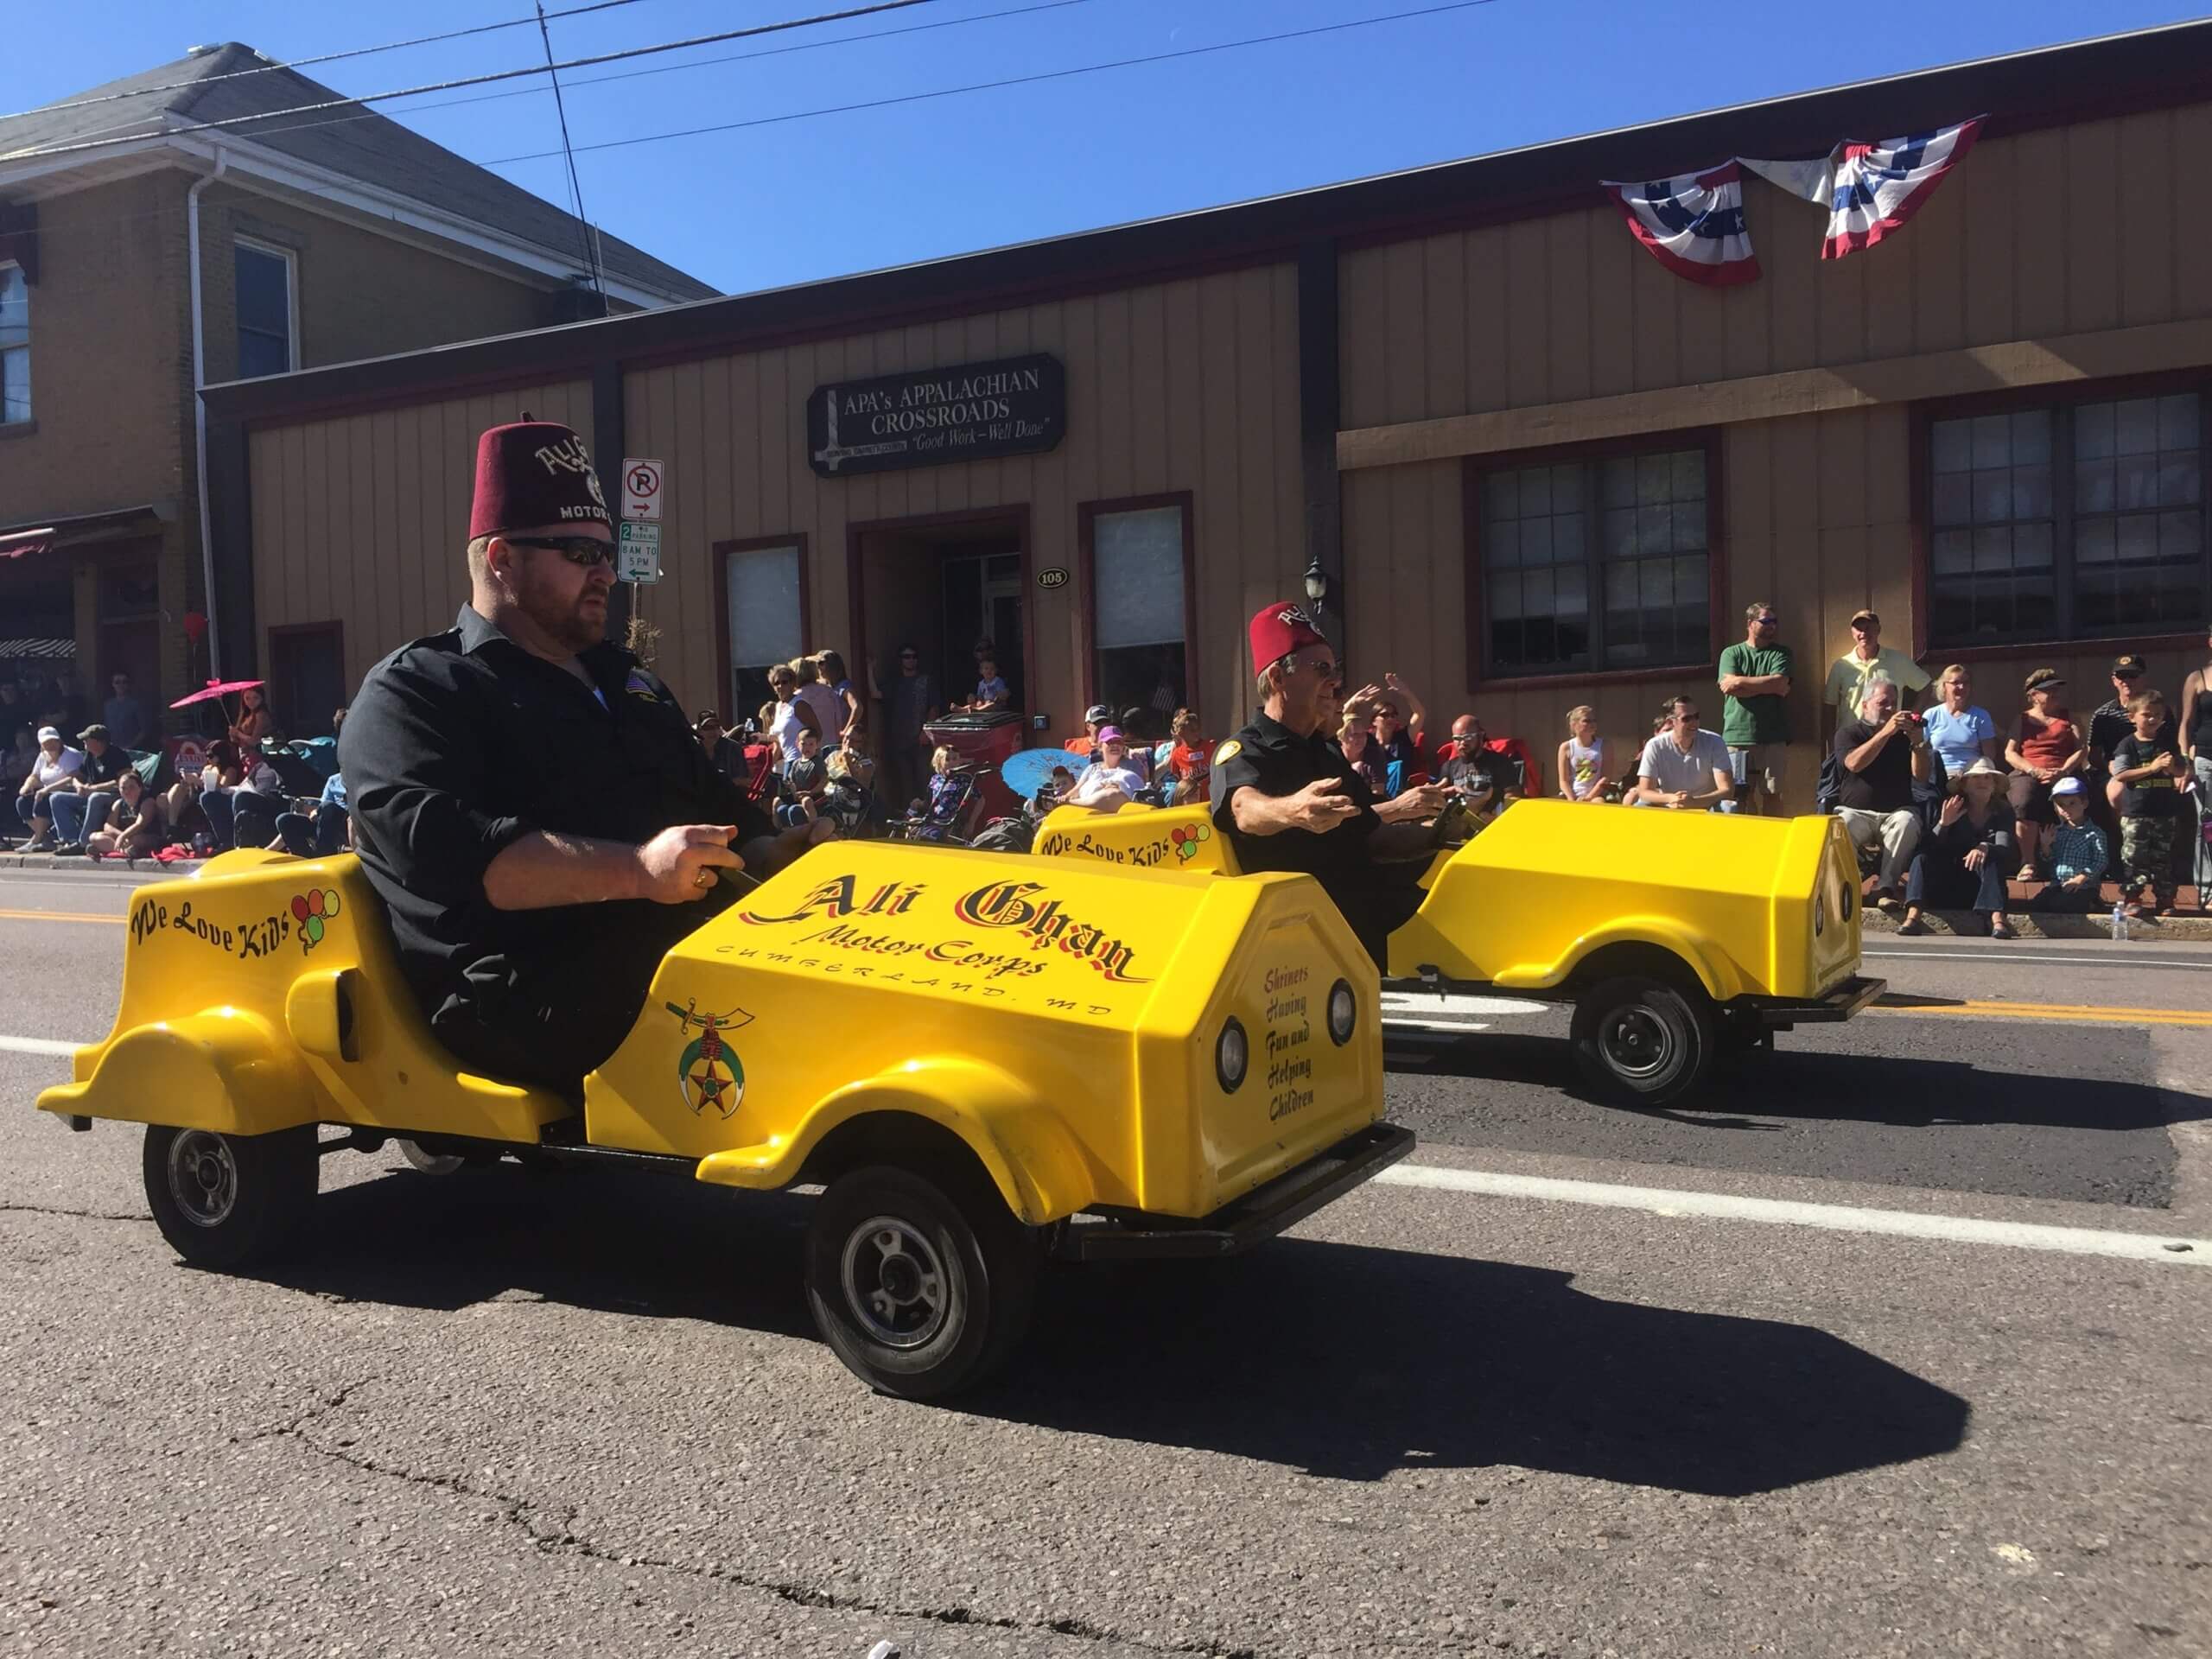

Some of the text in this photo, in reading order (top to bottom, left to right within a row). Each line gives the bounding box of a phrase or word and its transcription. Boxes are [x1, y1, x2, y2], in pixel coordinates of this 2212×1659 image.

[844, 369, 1039, 415] APA's APPALACHIAN
[871, 398, 1011, 435] CROSSROADS
[622, 526, 630, 538] 2
[646, 546, 657, 555] TO
[1042, 572, 1062, 584] 105
[1042, 833, 1071, 855] We
[1077, 834, 1123, 864] Love
[131, 899, 167, 945] We
[174, 901, 232, 951] Love
[738, 874, 1155, 983] Ali Ghan
[791, 924, 1048, 980] Motor Corps
[1264, 966, 1309, 994] Shriners
[1046, 997, 1112, 1016] MD
[1268, 993, 1306, 1023] Having
[1265, 1020, 1310, 1060] Fun and
[1268, 1056, 1313, 1090] Helping
[1268, 1089, 1313, 1122] Children
